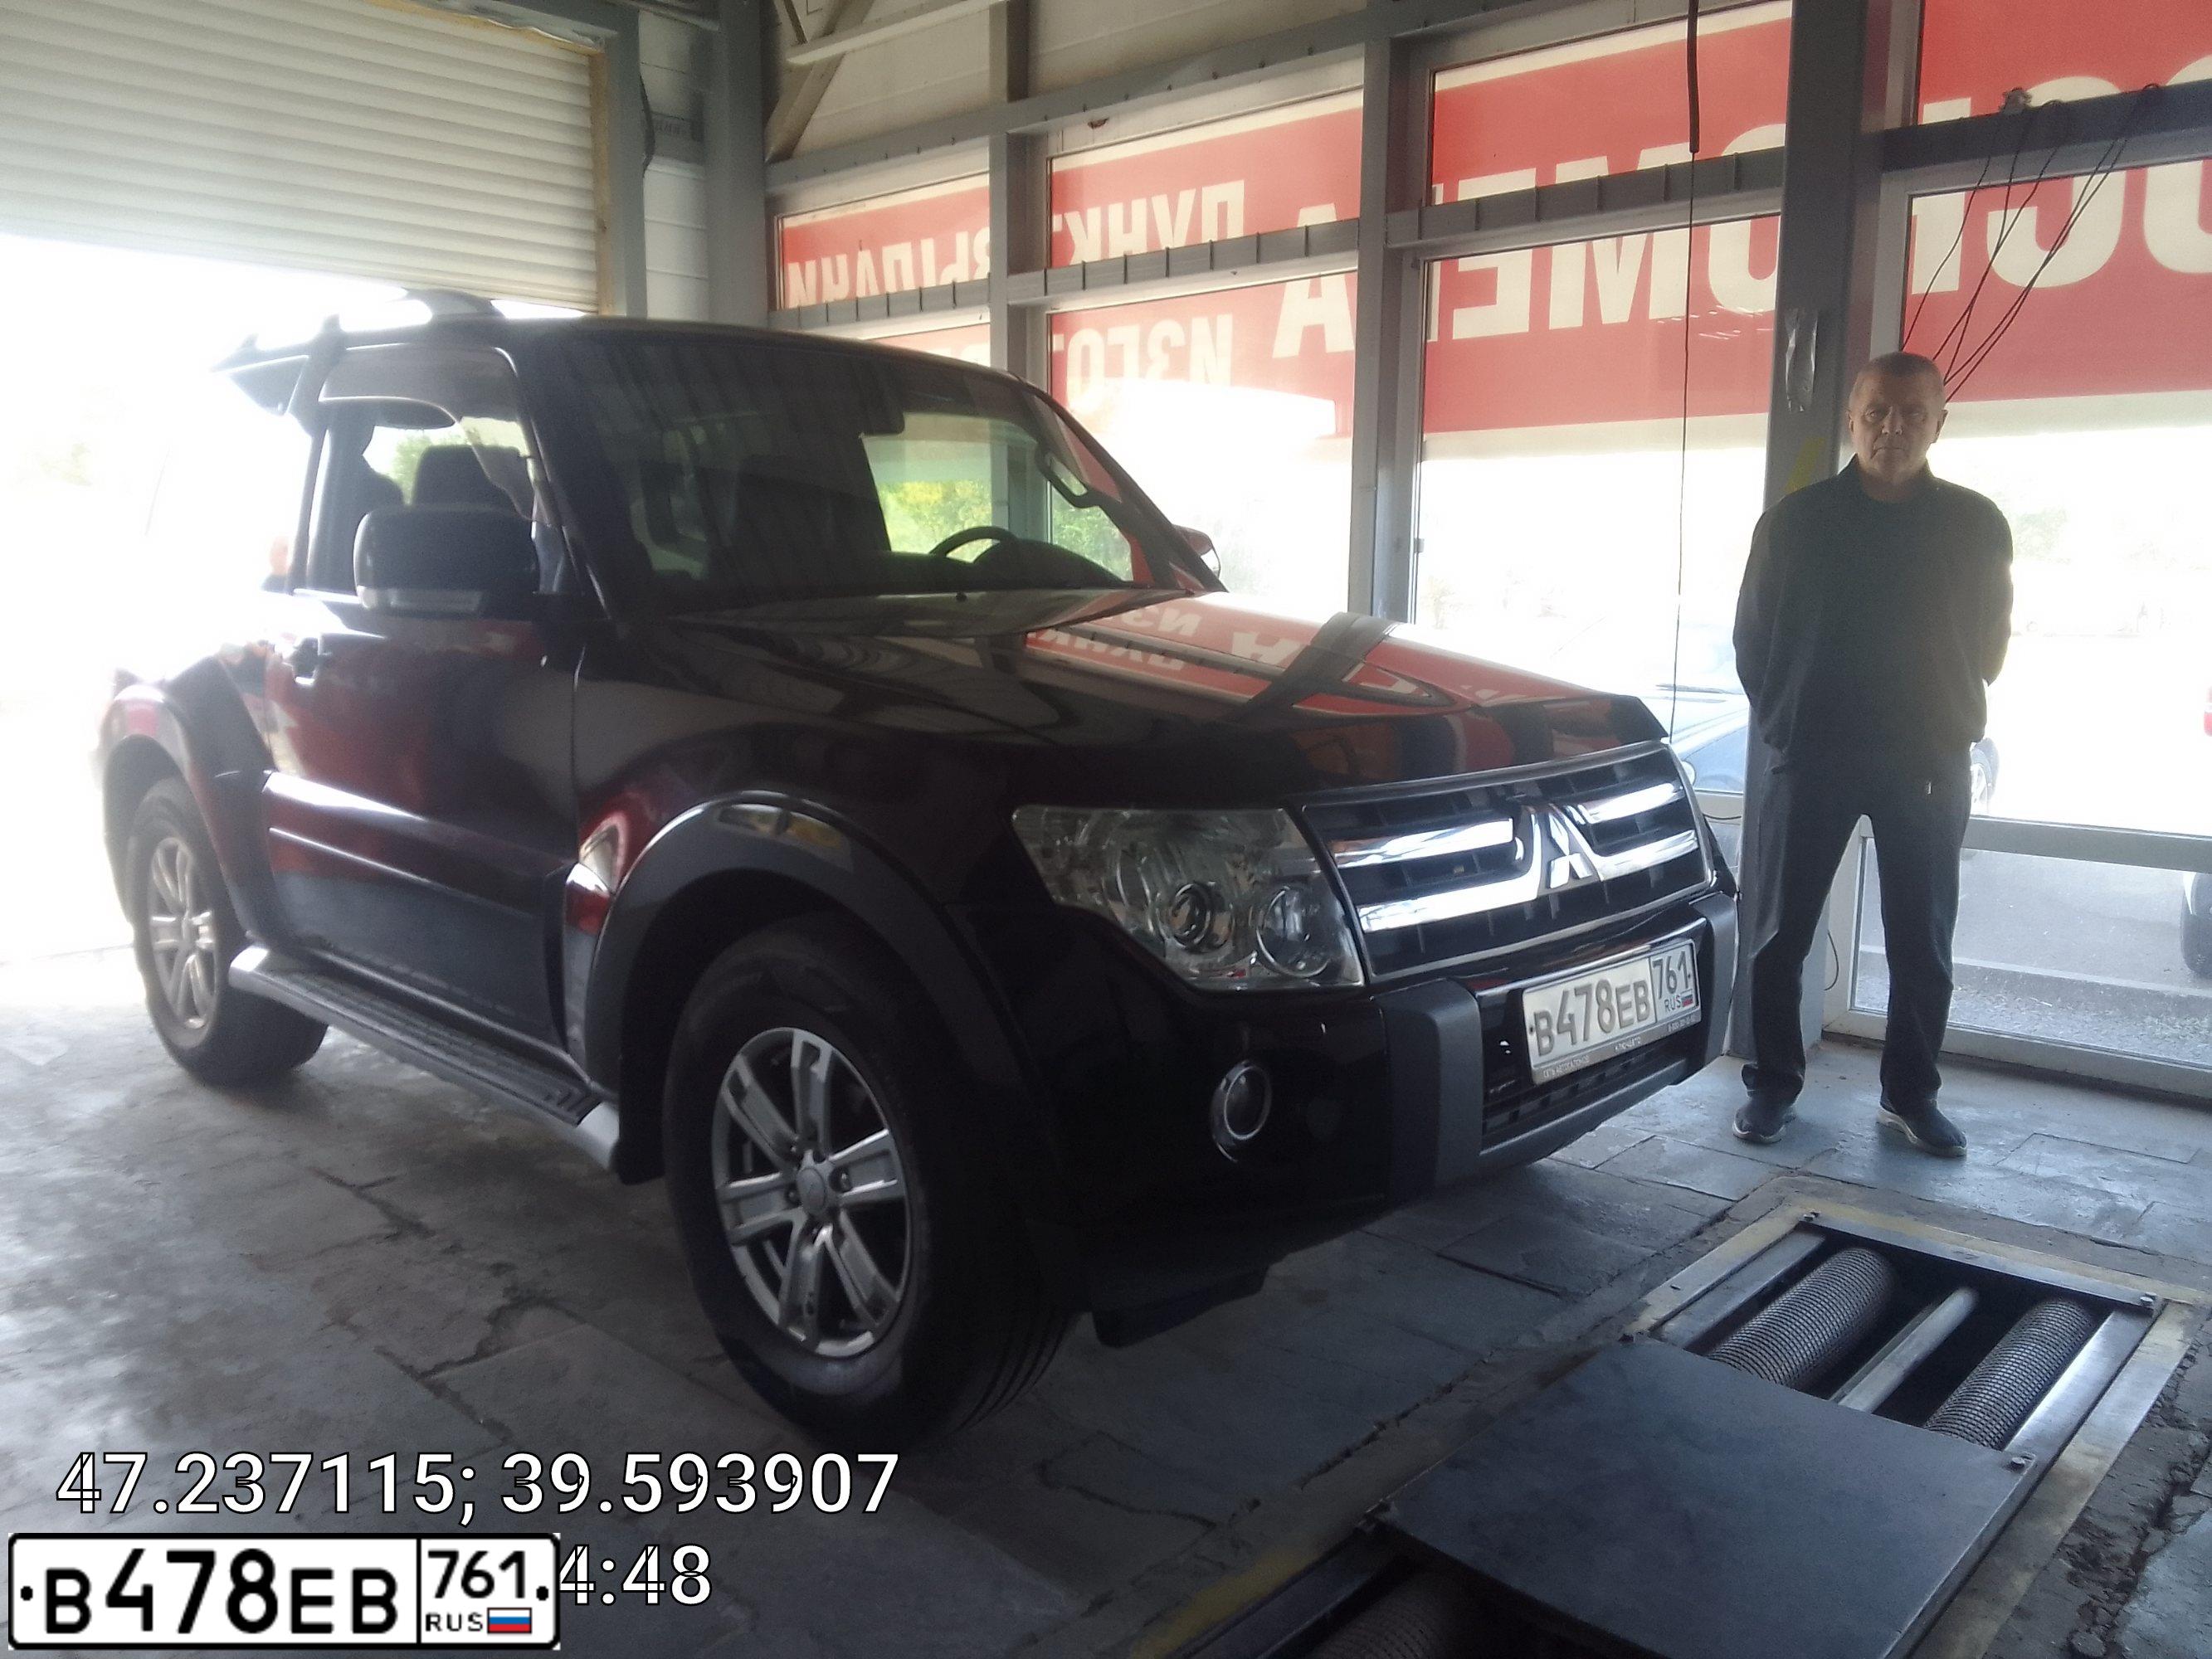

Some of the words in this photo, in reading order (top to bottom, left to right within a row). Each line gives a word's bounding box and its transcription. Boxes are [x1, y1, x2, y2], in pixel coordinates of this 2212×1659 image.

[1533, 979, 1651, 1057] В478ЕВ
[1652, 951, 1690, 1000] 761
[1664, 995, 1682, 1013] RUS
